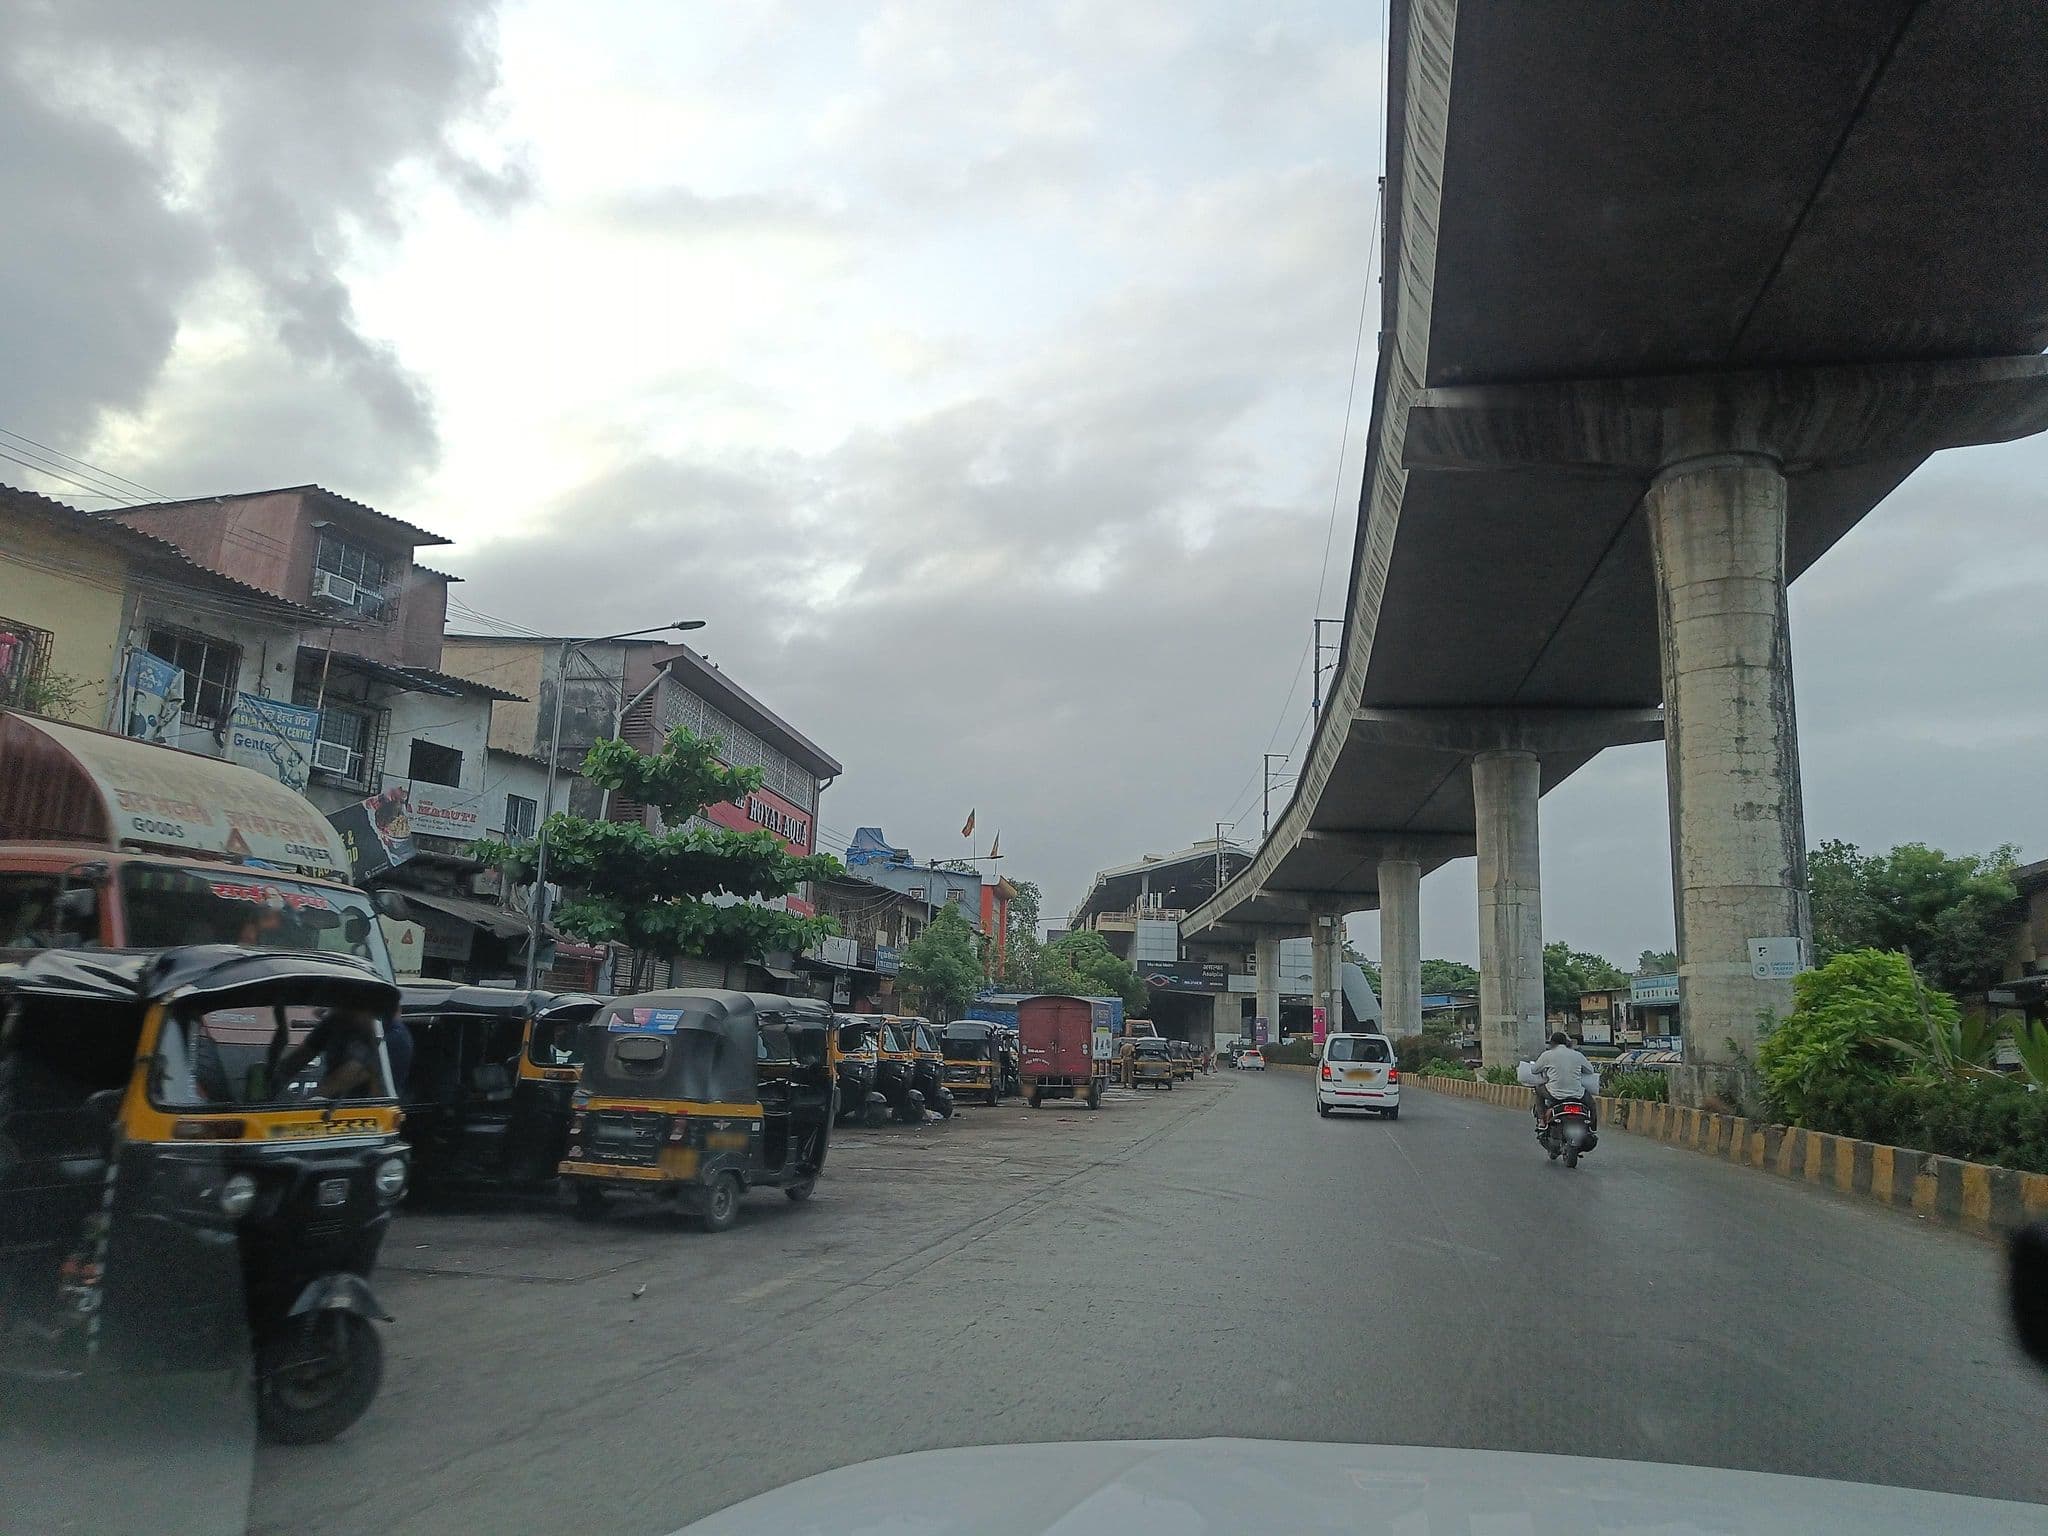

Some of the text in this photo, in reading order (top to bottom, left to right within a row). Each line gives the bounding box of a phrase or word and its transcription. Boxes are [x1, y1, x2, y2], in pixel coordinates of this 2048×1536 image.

[233, 733, 273, 752] Gents
[749, 796, 781, 833] ROYAL
[132, 816, 185, 839] GOODS
